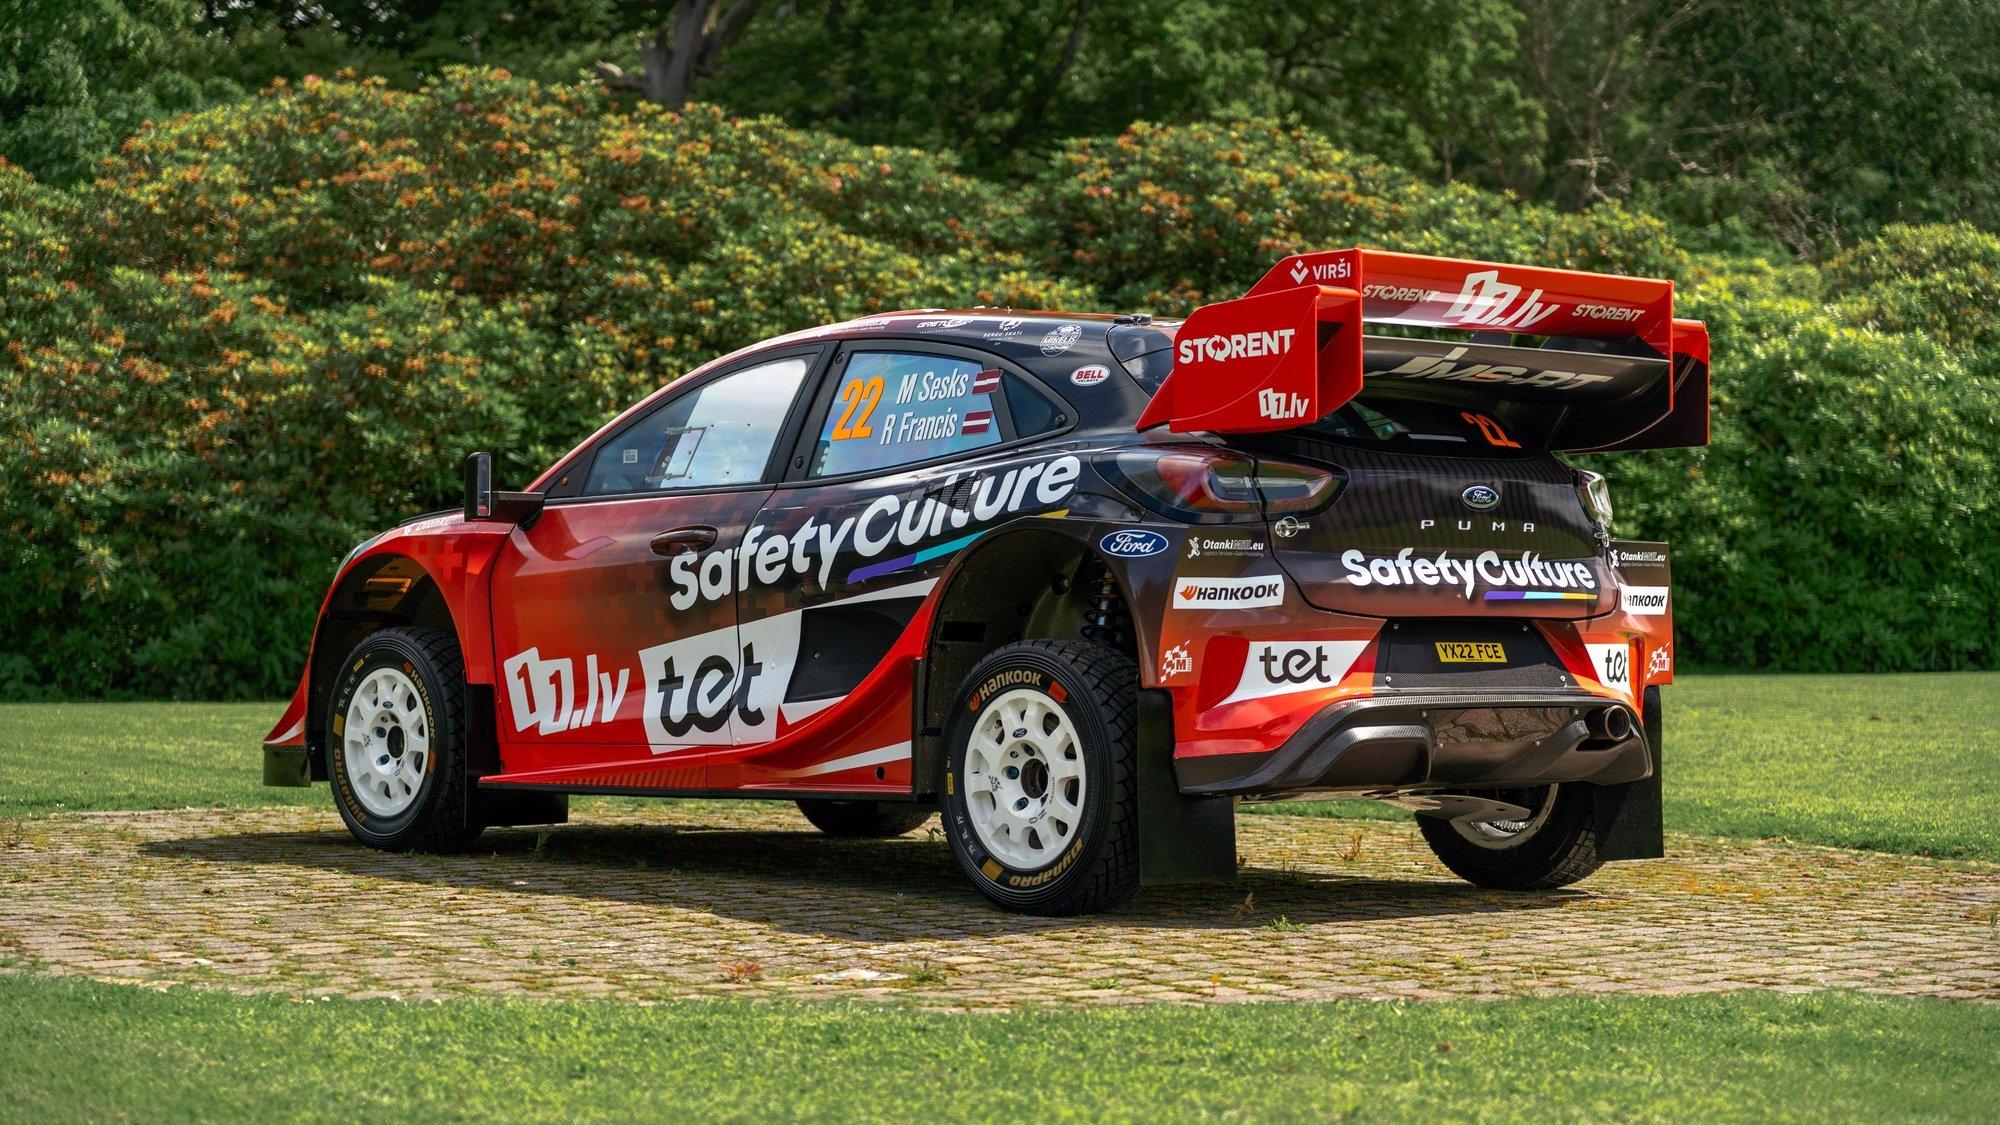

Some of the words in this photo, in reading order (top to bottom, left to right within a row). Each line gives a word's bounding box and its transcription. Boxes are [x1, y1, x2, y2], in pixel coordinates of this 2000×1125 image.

[1313, 258, 1350, 280] VIRŠI
[1362, 285, 1440, 303] STORENT
[1571, 304, 1646, 321] STORENT
[1179, 328, 1295, 364] STORENT
[896, 373, 918, 405] M
[918, 368, 969, 402] Sesks
[1076, 370, 1103, 380] BELL
[831, 376, 885, 441] 22
[1258, 388, 1309, 419] 11.lv
[880, 413, 896, 445] R
[897, 407, 958, 443] Francis
[1473, 490, 1492, 503] Ford
[670, 455, 1080, 611] SafetyCulture
[1111, 532, 1158, 553] Ford
[1421, 520, 1535, 532] PUMA
[1341, 547, 1596, 600] SafetyCulture
[1259, 646, 1331, 684] tet
[1440, 644, 1475, 659] YX22
[1476, 644, 1502, 659] FCE
[503, 647, 629, 736] 11.lv
[657, 641, 767, 737] tet
